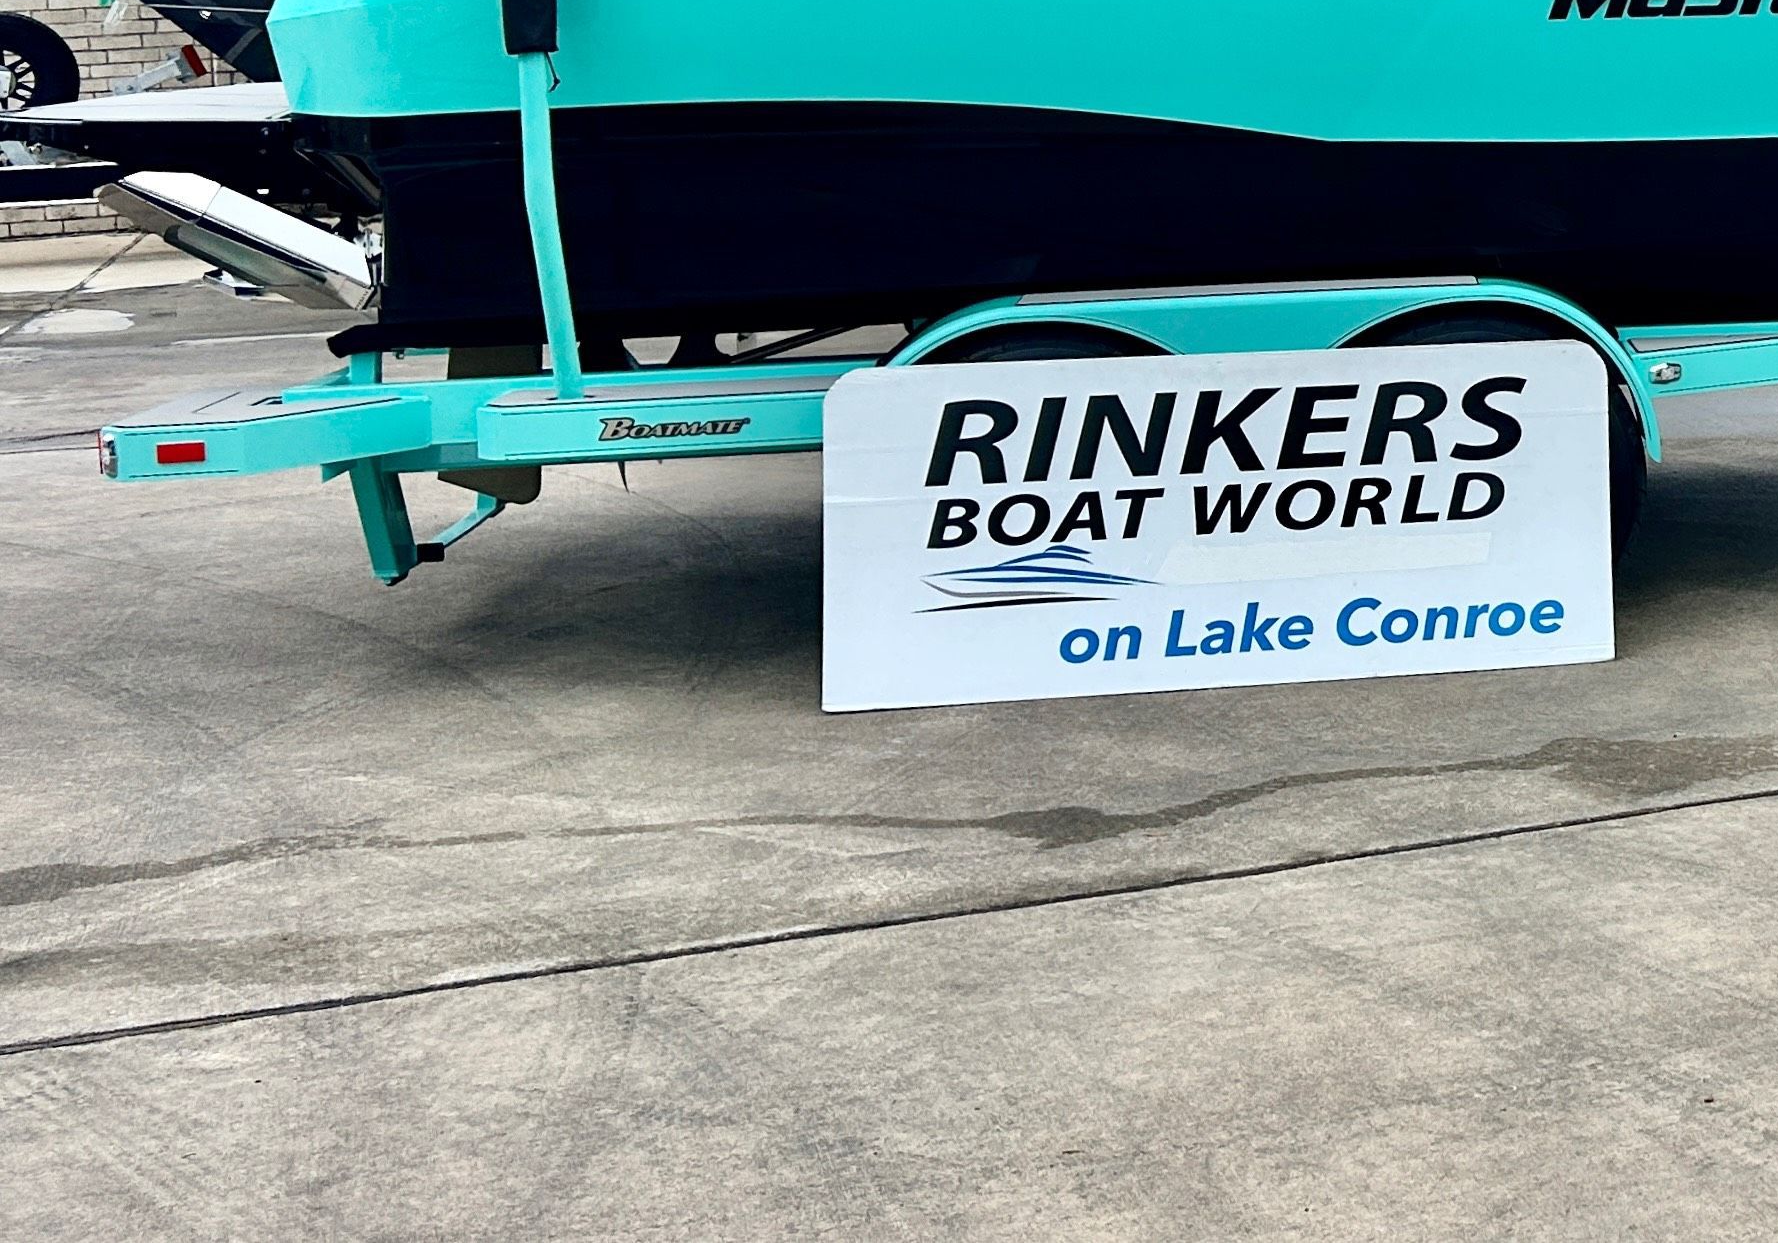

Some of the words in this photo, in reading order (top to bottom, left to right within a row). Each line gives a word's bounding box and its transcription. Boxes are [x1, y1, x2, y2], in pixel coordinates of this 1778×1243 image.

[925, 377, 1526, 486] RINKERS
[927, 488, 1164, 548] BOAT
[1194, 472, 1504, 536] WORLD
[1060, 626, 1143, 664] on
[1164, 602, 1314, 657] Lake
[1336, 598, 1565, 647] Conroe
